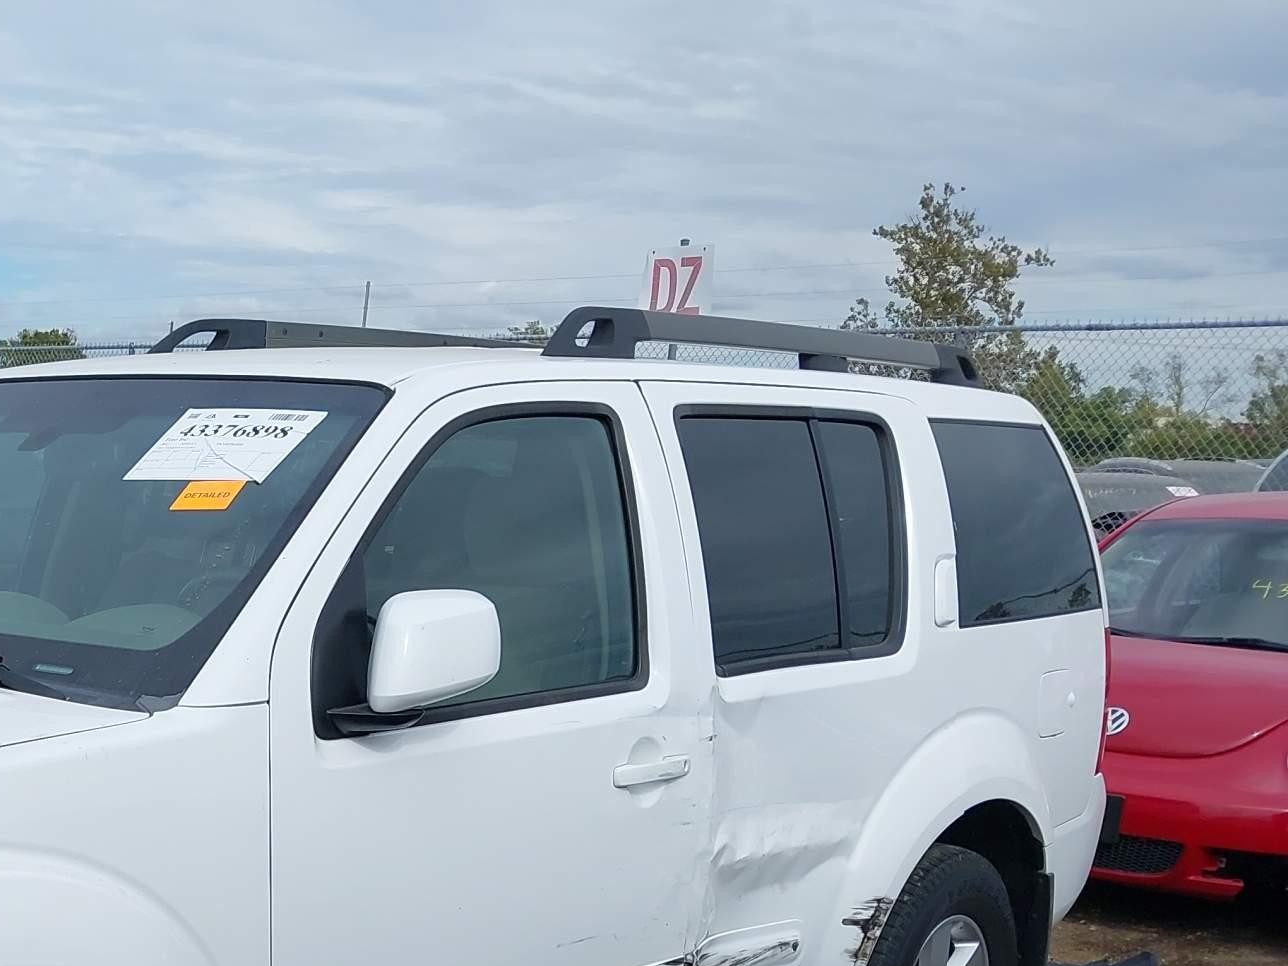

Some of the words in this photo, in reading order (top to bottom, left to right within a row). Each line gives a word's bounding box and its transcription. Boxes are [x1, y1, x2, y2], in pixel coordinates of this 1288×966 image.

[649, 256, 703, 315] DZ
[180, 424, 293, 439] 43376898
[183, 491, 231, 499] DETAILED
